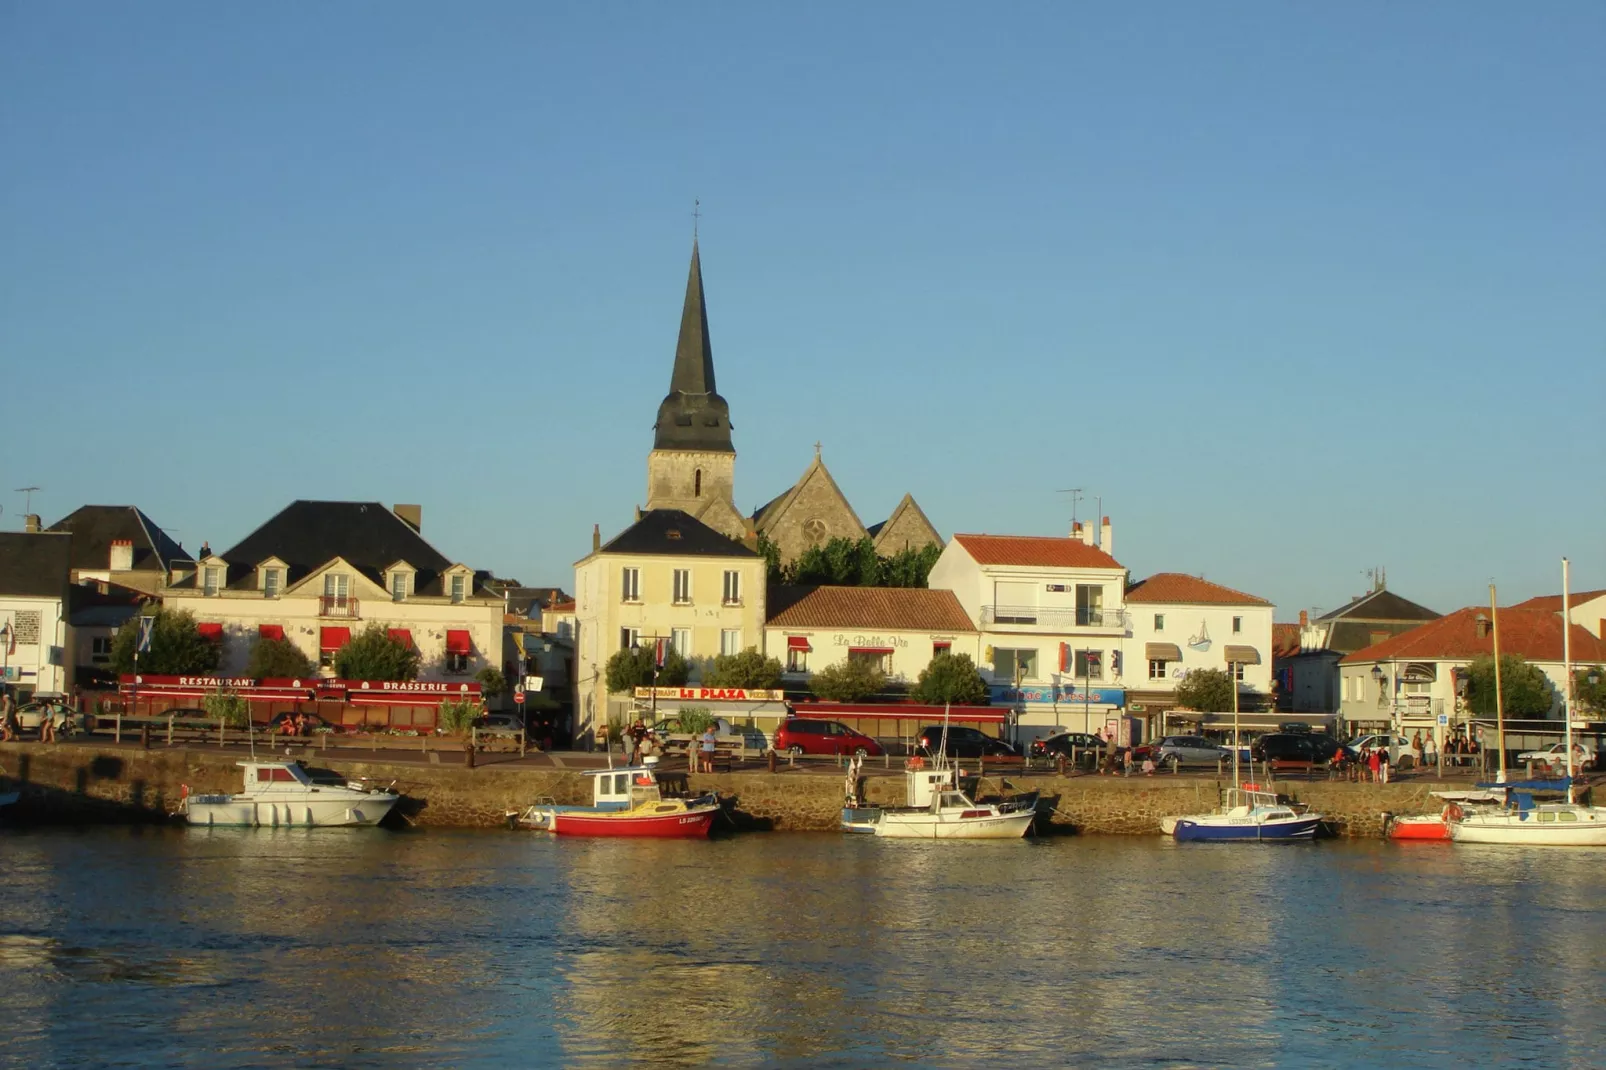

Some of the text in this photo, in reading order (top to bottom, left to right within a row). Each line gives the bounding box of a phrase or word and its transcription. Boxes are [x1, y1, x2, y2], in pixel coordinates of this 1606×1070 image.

[833, 634, 909, 648] La Belle Vie
[180, 677, 256, 686] RESTAURANT
[384, 682, 448, 691] BRASSERIE
[638, 689, 677, 697] RESTURANT
[700, 688, 746, 699] PLAZA
[1056, 692, 1102, 703] presse
